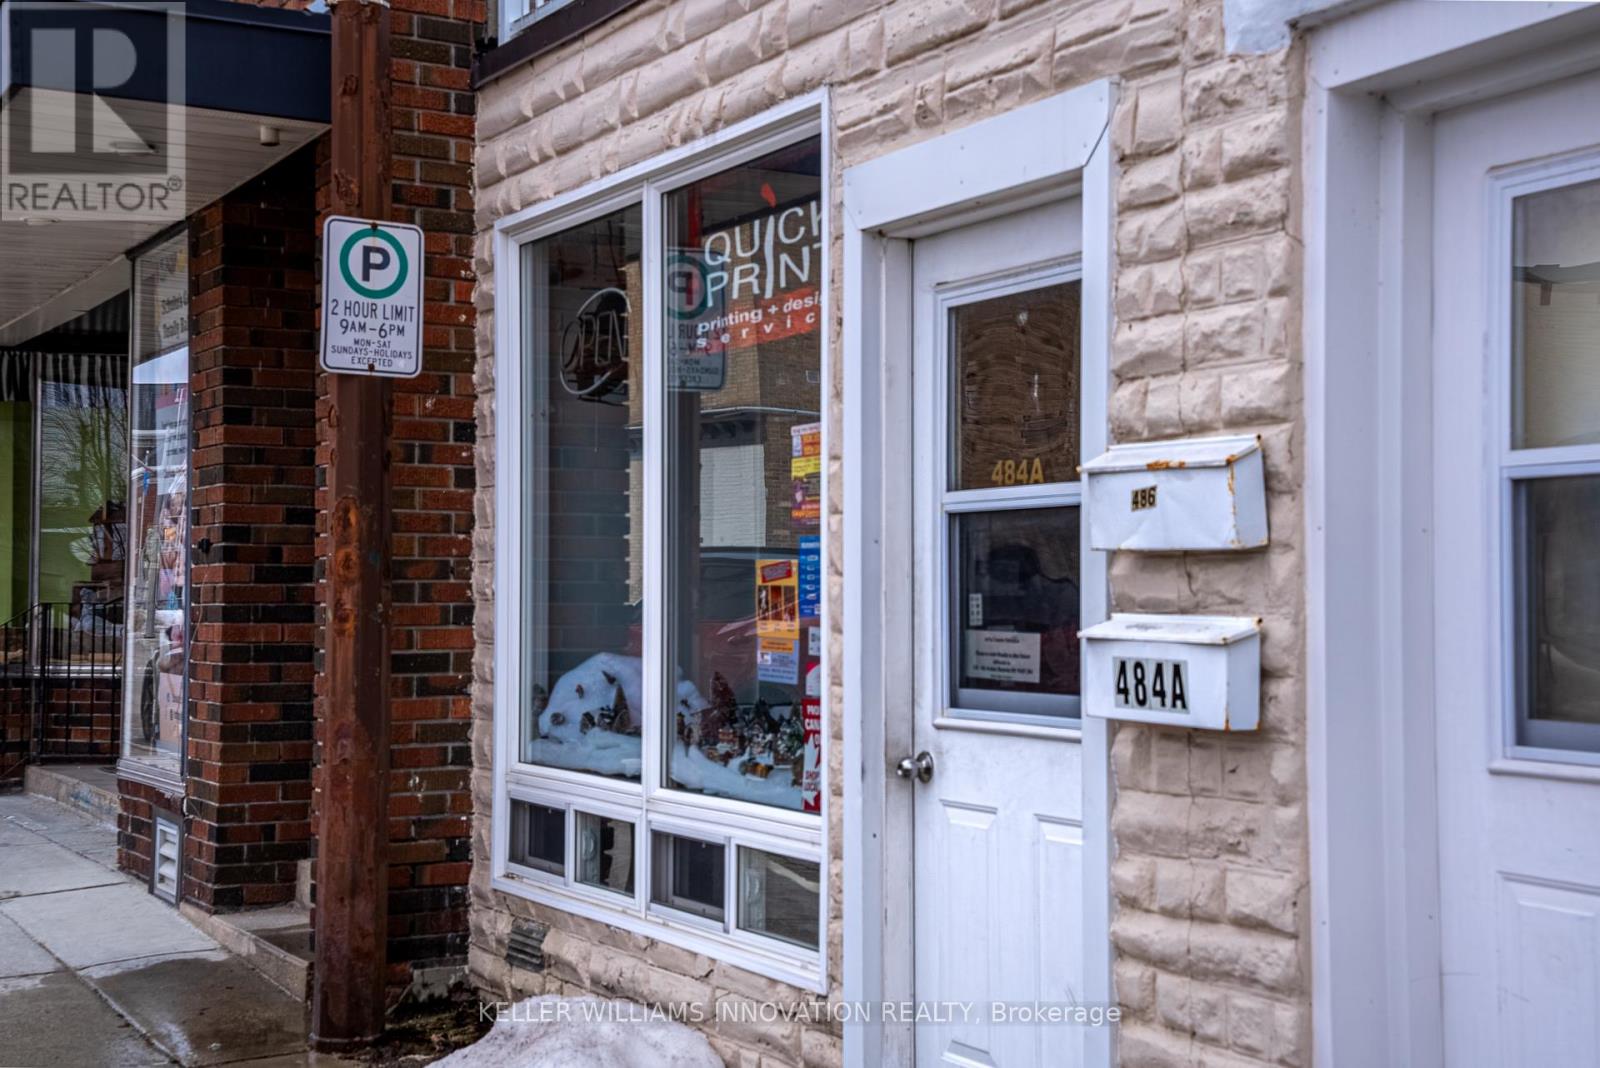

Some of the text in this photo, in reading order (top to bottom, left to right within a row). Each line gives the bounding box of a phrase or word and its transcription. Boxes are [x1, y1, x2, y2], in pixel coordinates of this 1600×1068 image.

[361, 245, 391, 282] P
[330, 299, 415, 322] 2 HOUR LIMIT
[697, 308, 763, 335] printing
[783, 291, 821, 314] desi
[351, 357, 393, 368] EXCEPTED
[991, 457, 1044, 485] 484A
[1132, 487, 1157, 509] 486
[1116, 660, 1187, 709] 484A
